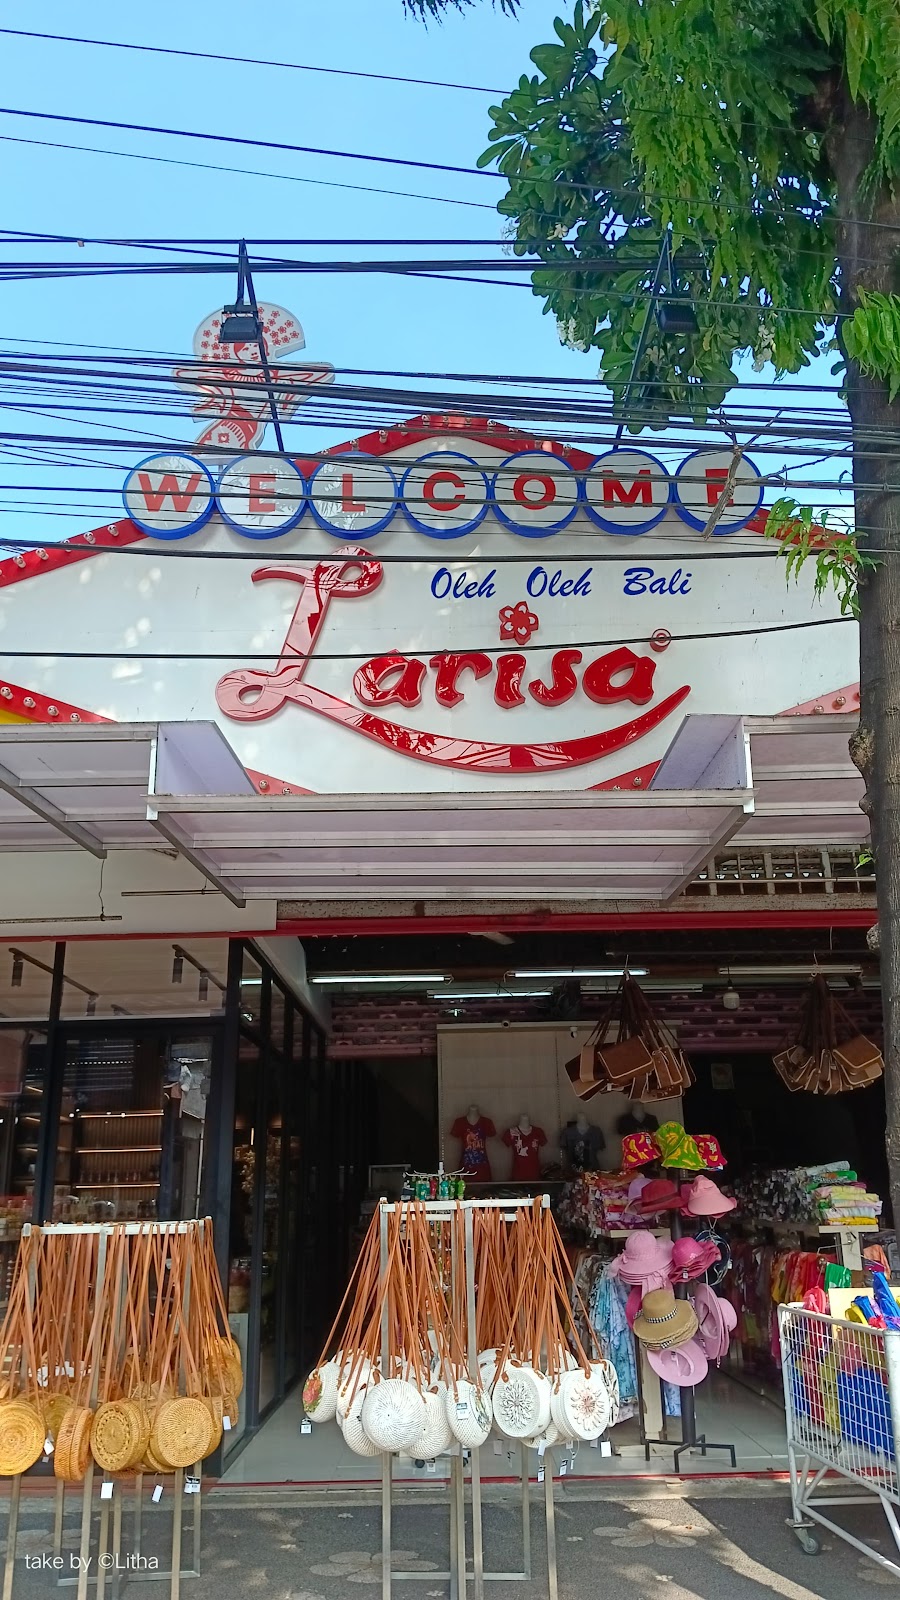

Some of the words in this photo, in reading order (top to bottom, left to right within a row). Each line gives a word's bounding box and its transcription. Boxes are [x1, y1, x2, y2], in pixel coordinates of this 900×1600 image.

[138, 467, 734, 513] WELCOME
[430, 567, 496, 598] Oleh
[526, 566, 593, 597] Oleh
[623, 567, 692, 596] Bali
[215, 546, 691, 774] Larisa
